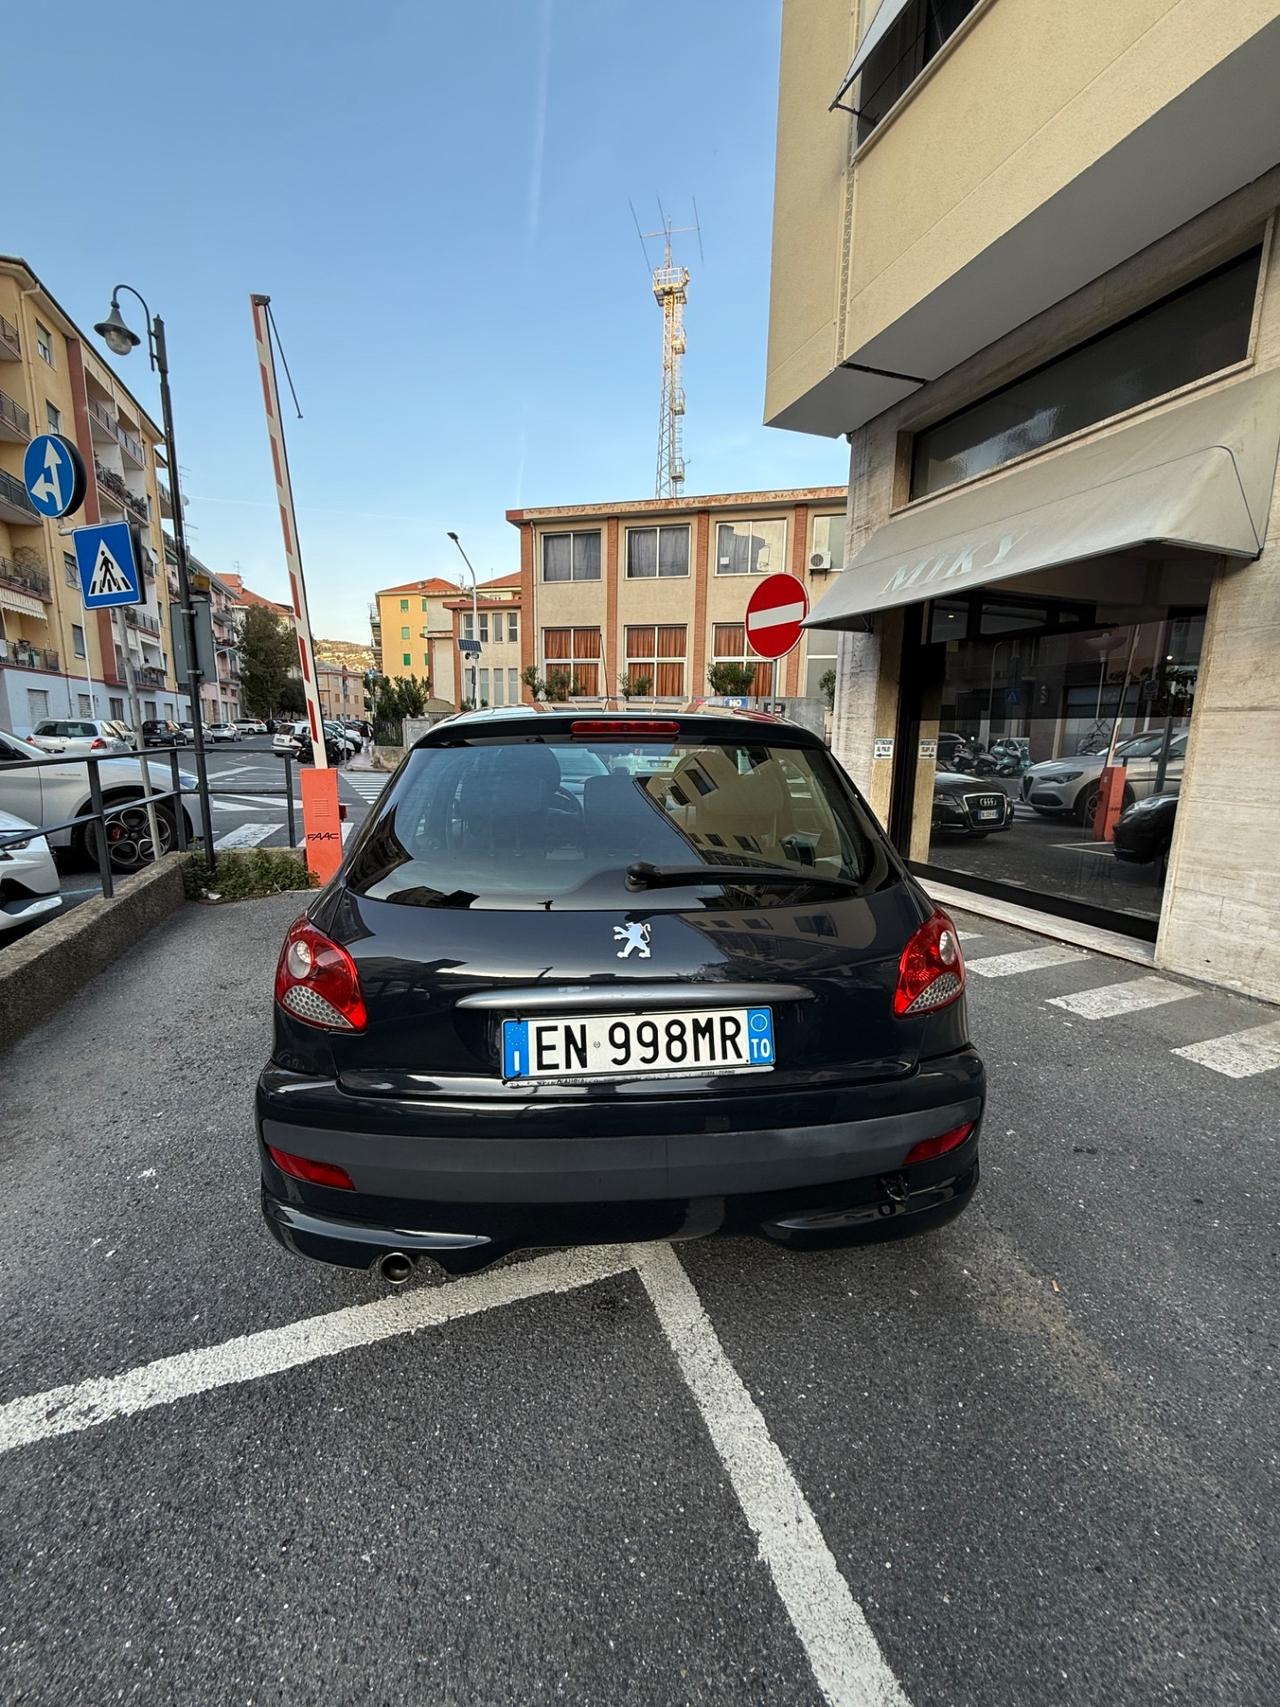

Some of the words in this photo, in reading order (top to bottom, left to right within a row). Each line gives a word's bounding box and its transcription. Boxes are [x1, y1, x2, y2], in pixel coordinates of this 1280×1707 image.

[307, 832, 339, 841] FAAC
[514, 1050, 520, 1071] I
[535, 1024, 588, 1071] EN
[608, 1016, 743, 1065] 998MR
[751, 1038, 770, 1058] TO
